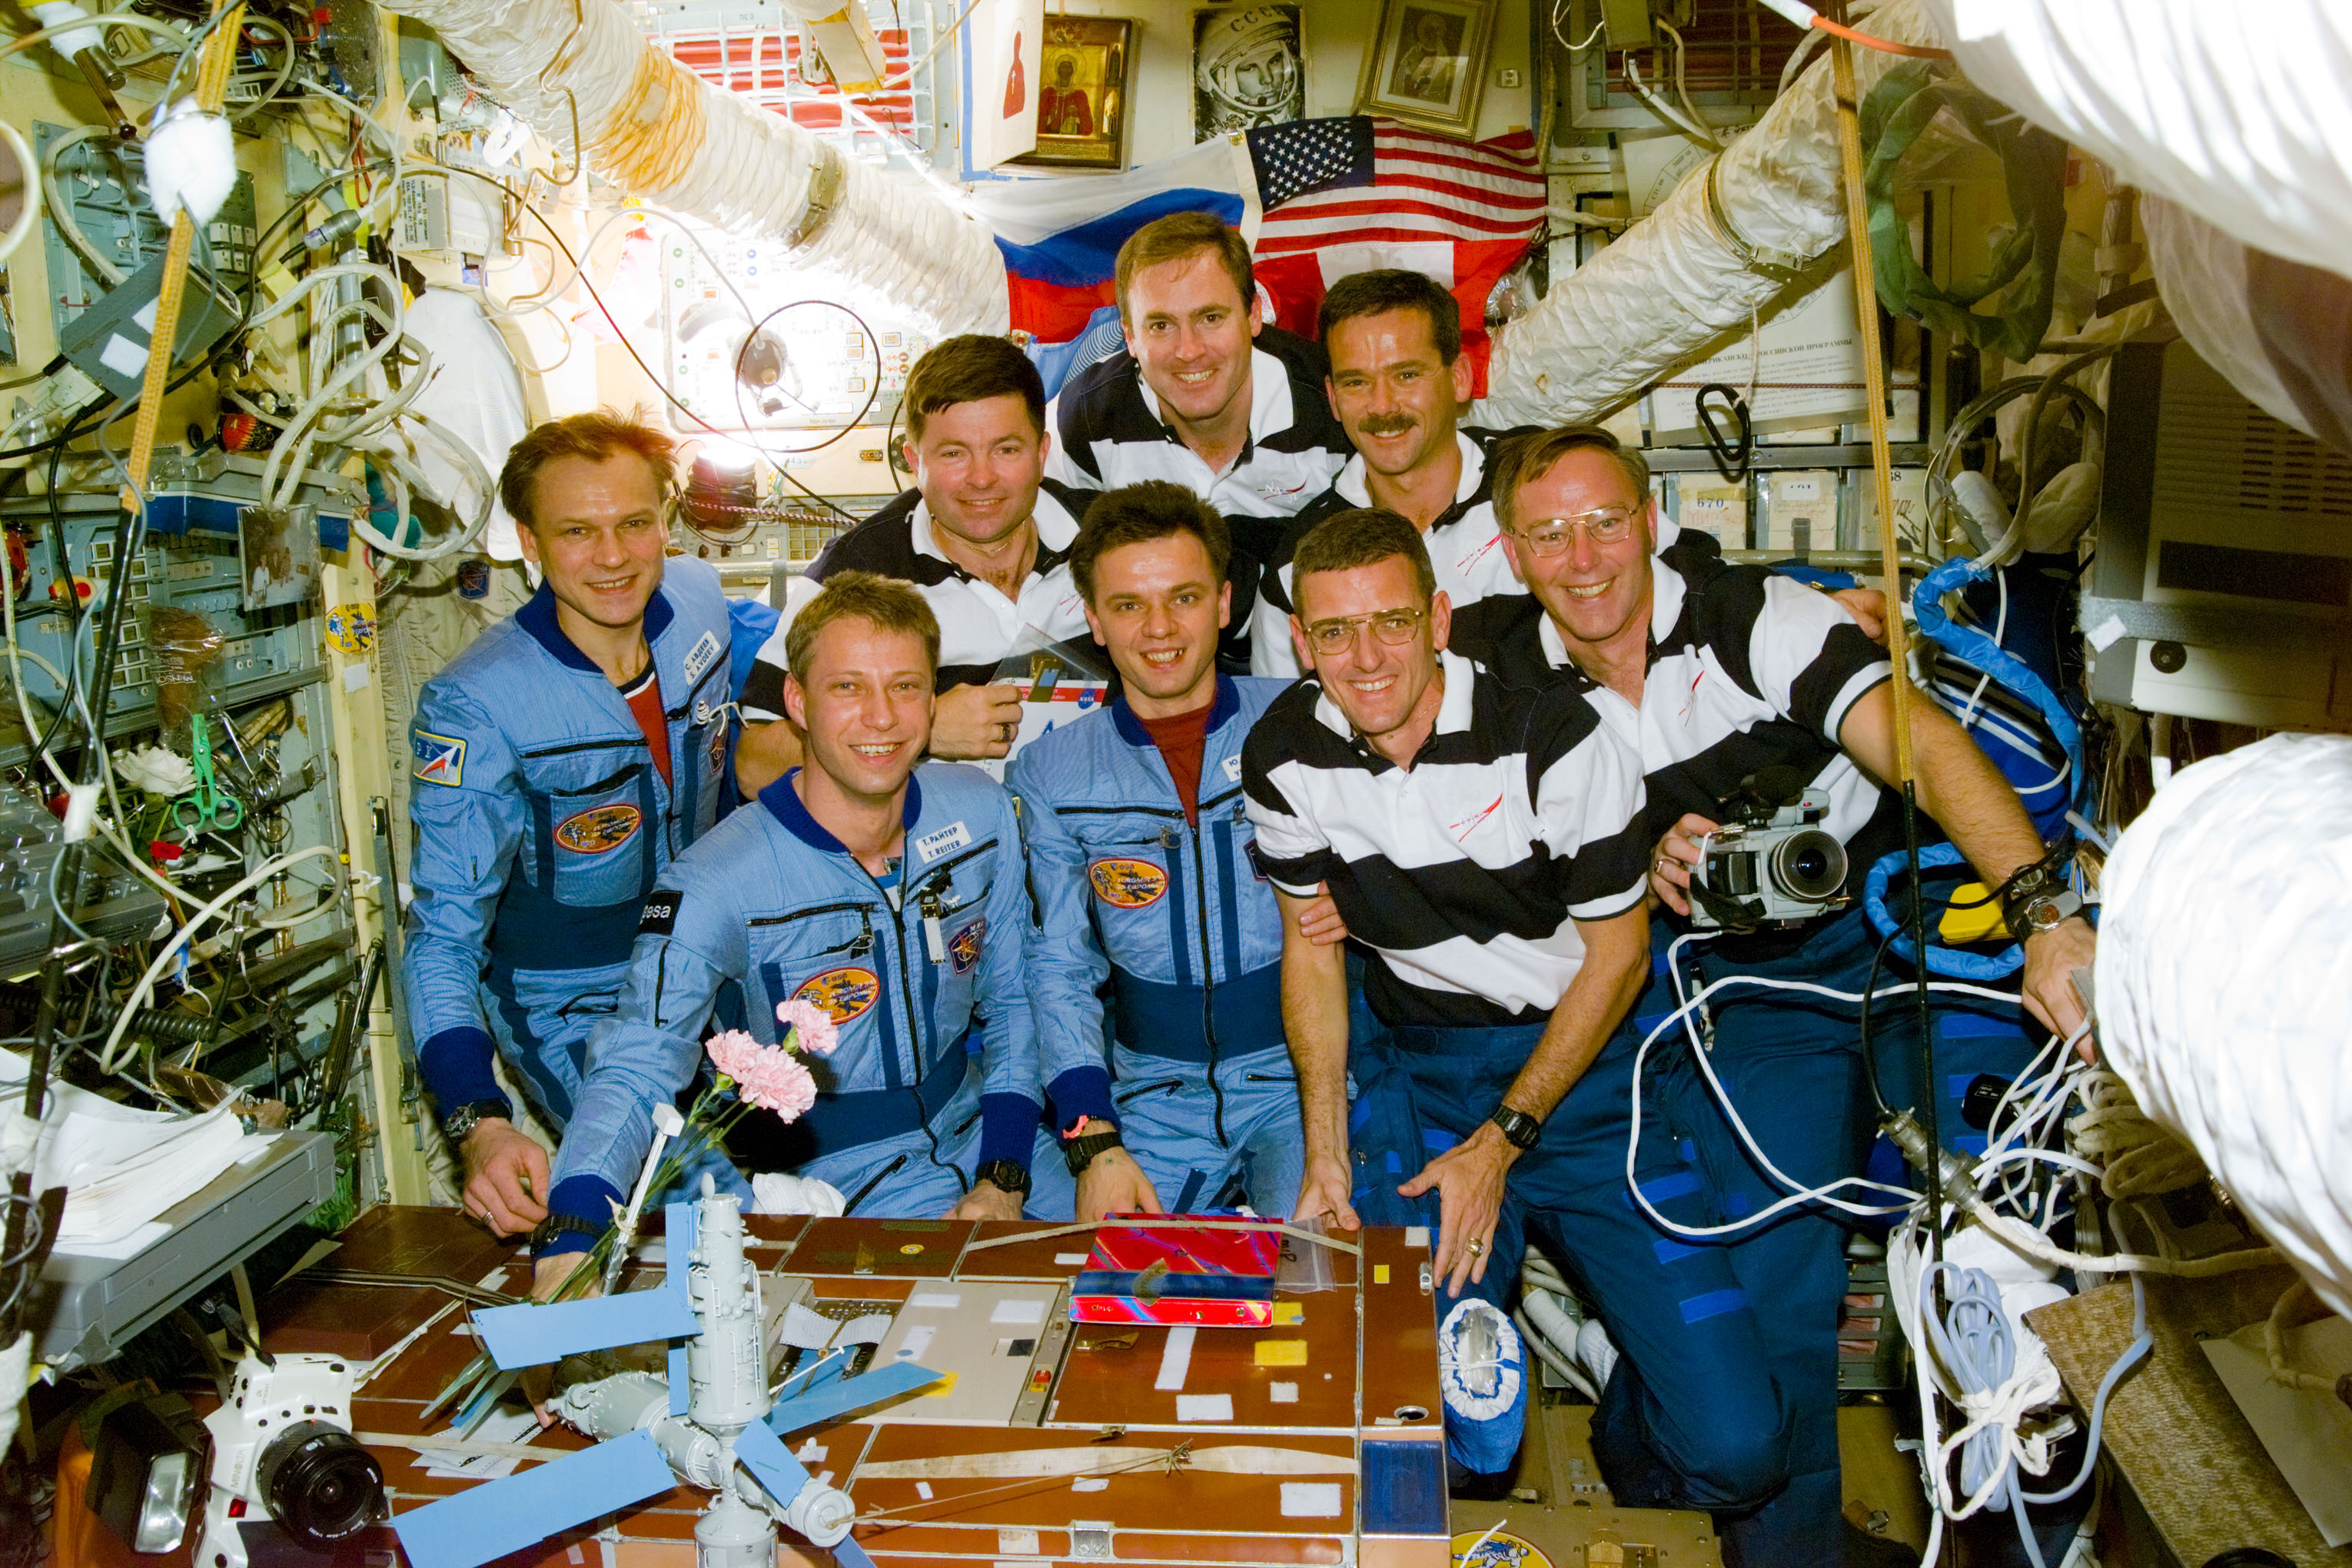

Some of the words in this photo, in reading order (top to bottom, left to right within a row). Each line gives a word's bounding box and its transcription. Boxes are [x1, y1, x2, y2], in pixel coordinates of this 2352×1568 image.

[1697, 497, 1724, 509] 670
[929, 826, 958, 843] РАЙТЕР
[935, 840, 961, 855] REITER
[230, 1448, 246, 1489] MINOLTA
